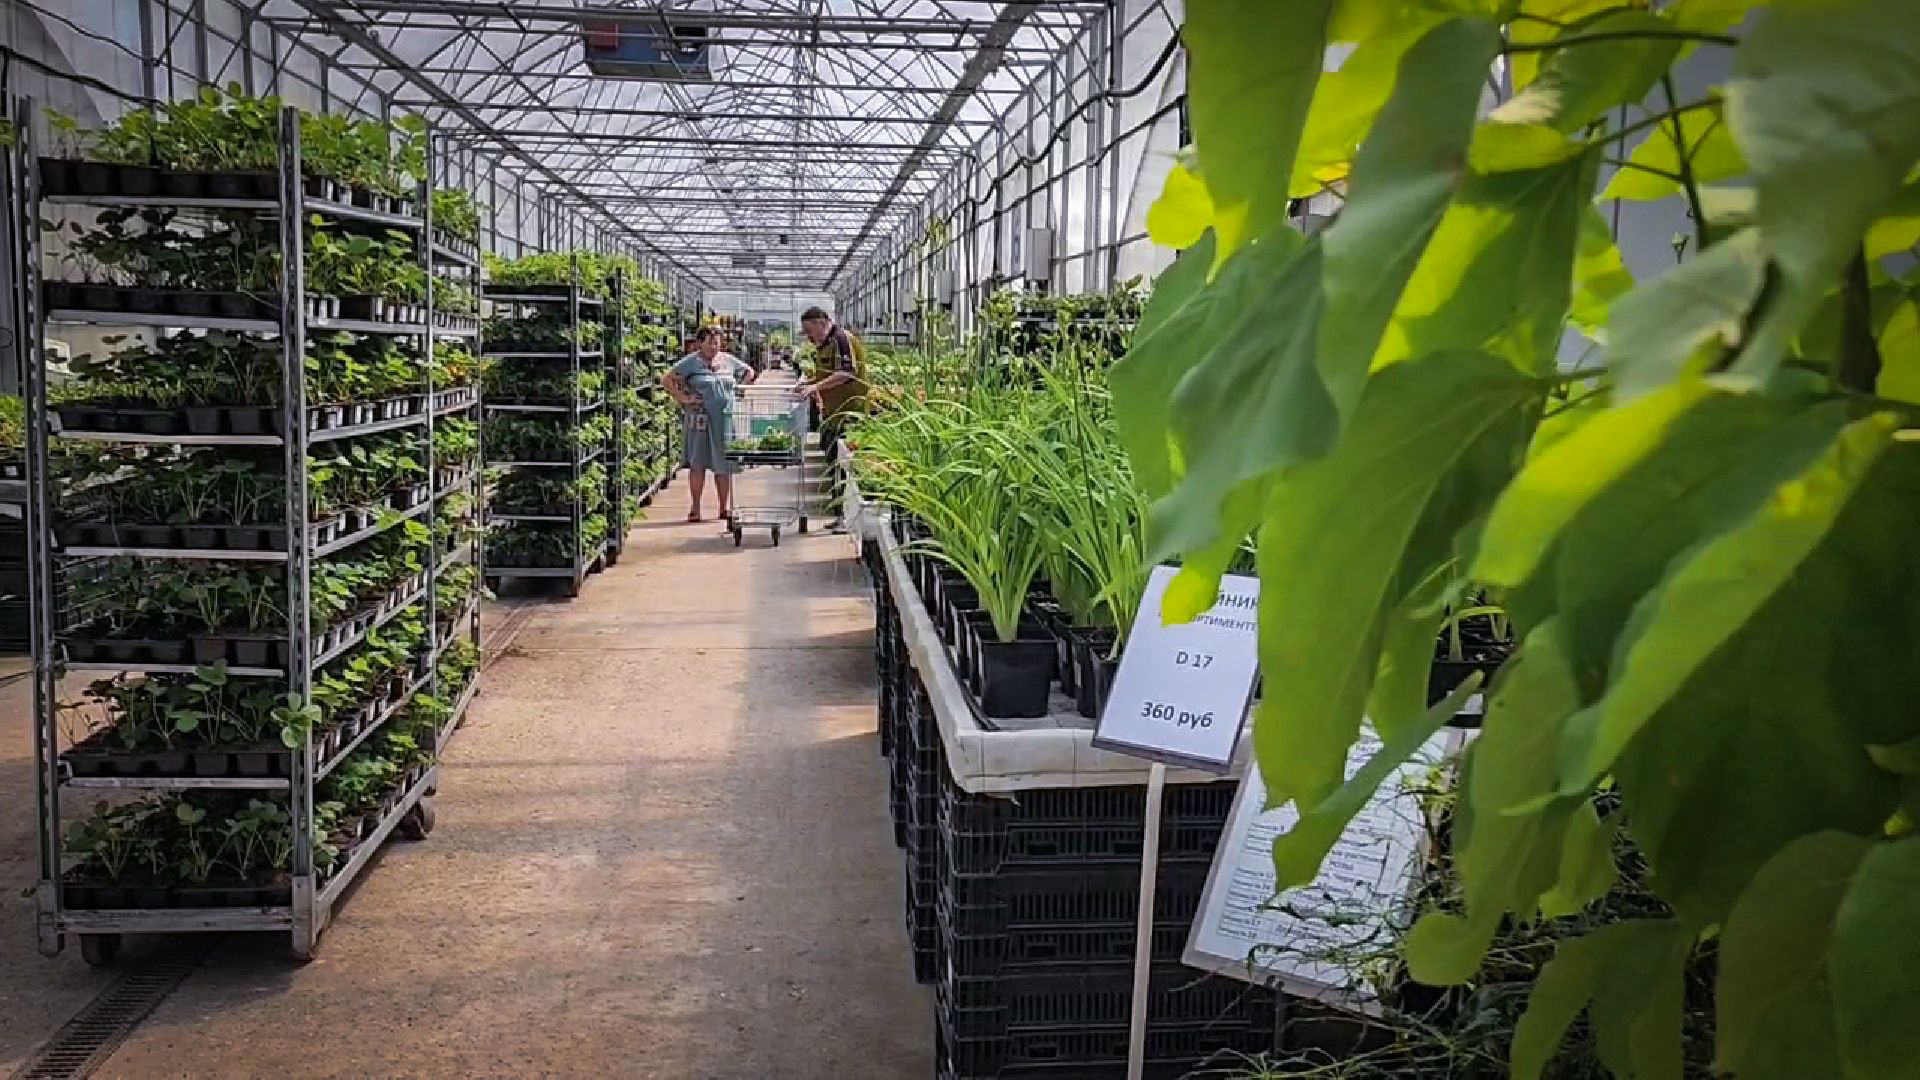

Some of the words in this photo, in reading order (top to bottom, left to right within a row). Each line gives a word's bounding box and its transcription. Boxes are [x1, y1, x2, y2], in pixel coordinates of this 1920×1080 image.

[1176, 650, 1189, 664] D
[1192, 654, 1213, 668] 17
[1141, 701, 1174, 720] 360
[1177, 711, 1214, 729] руб
